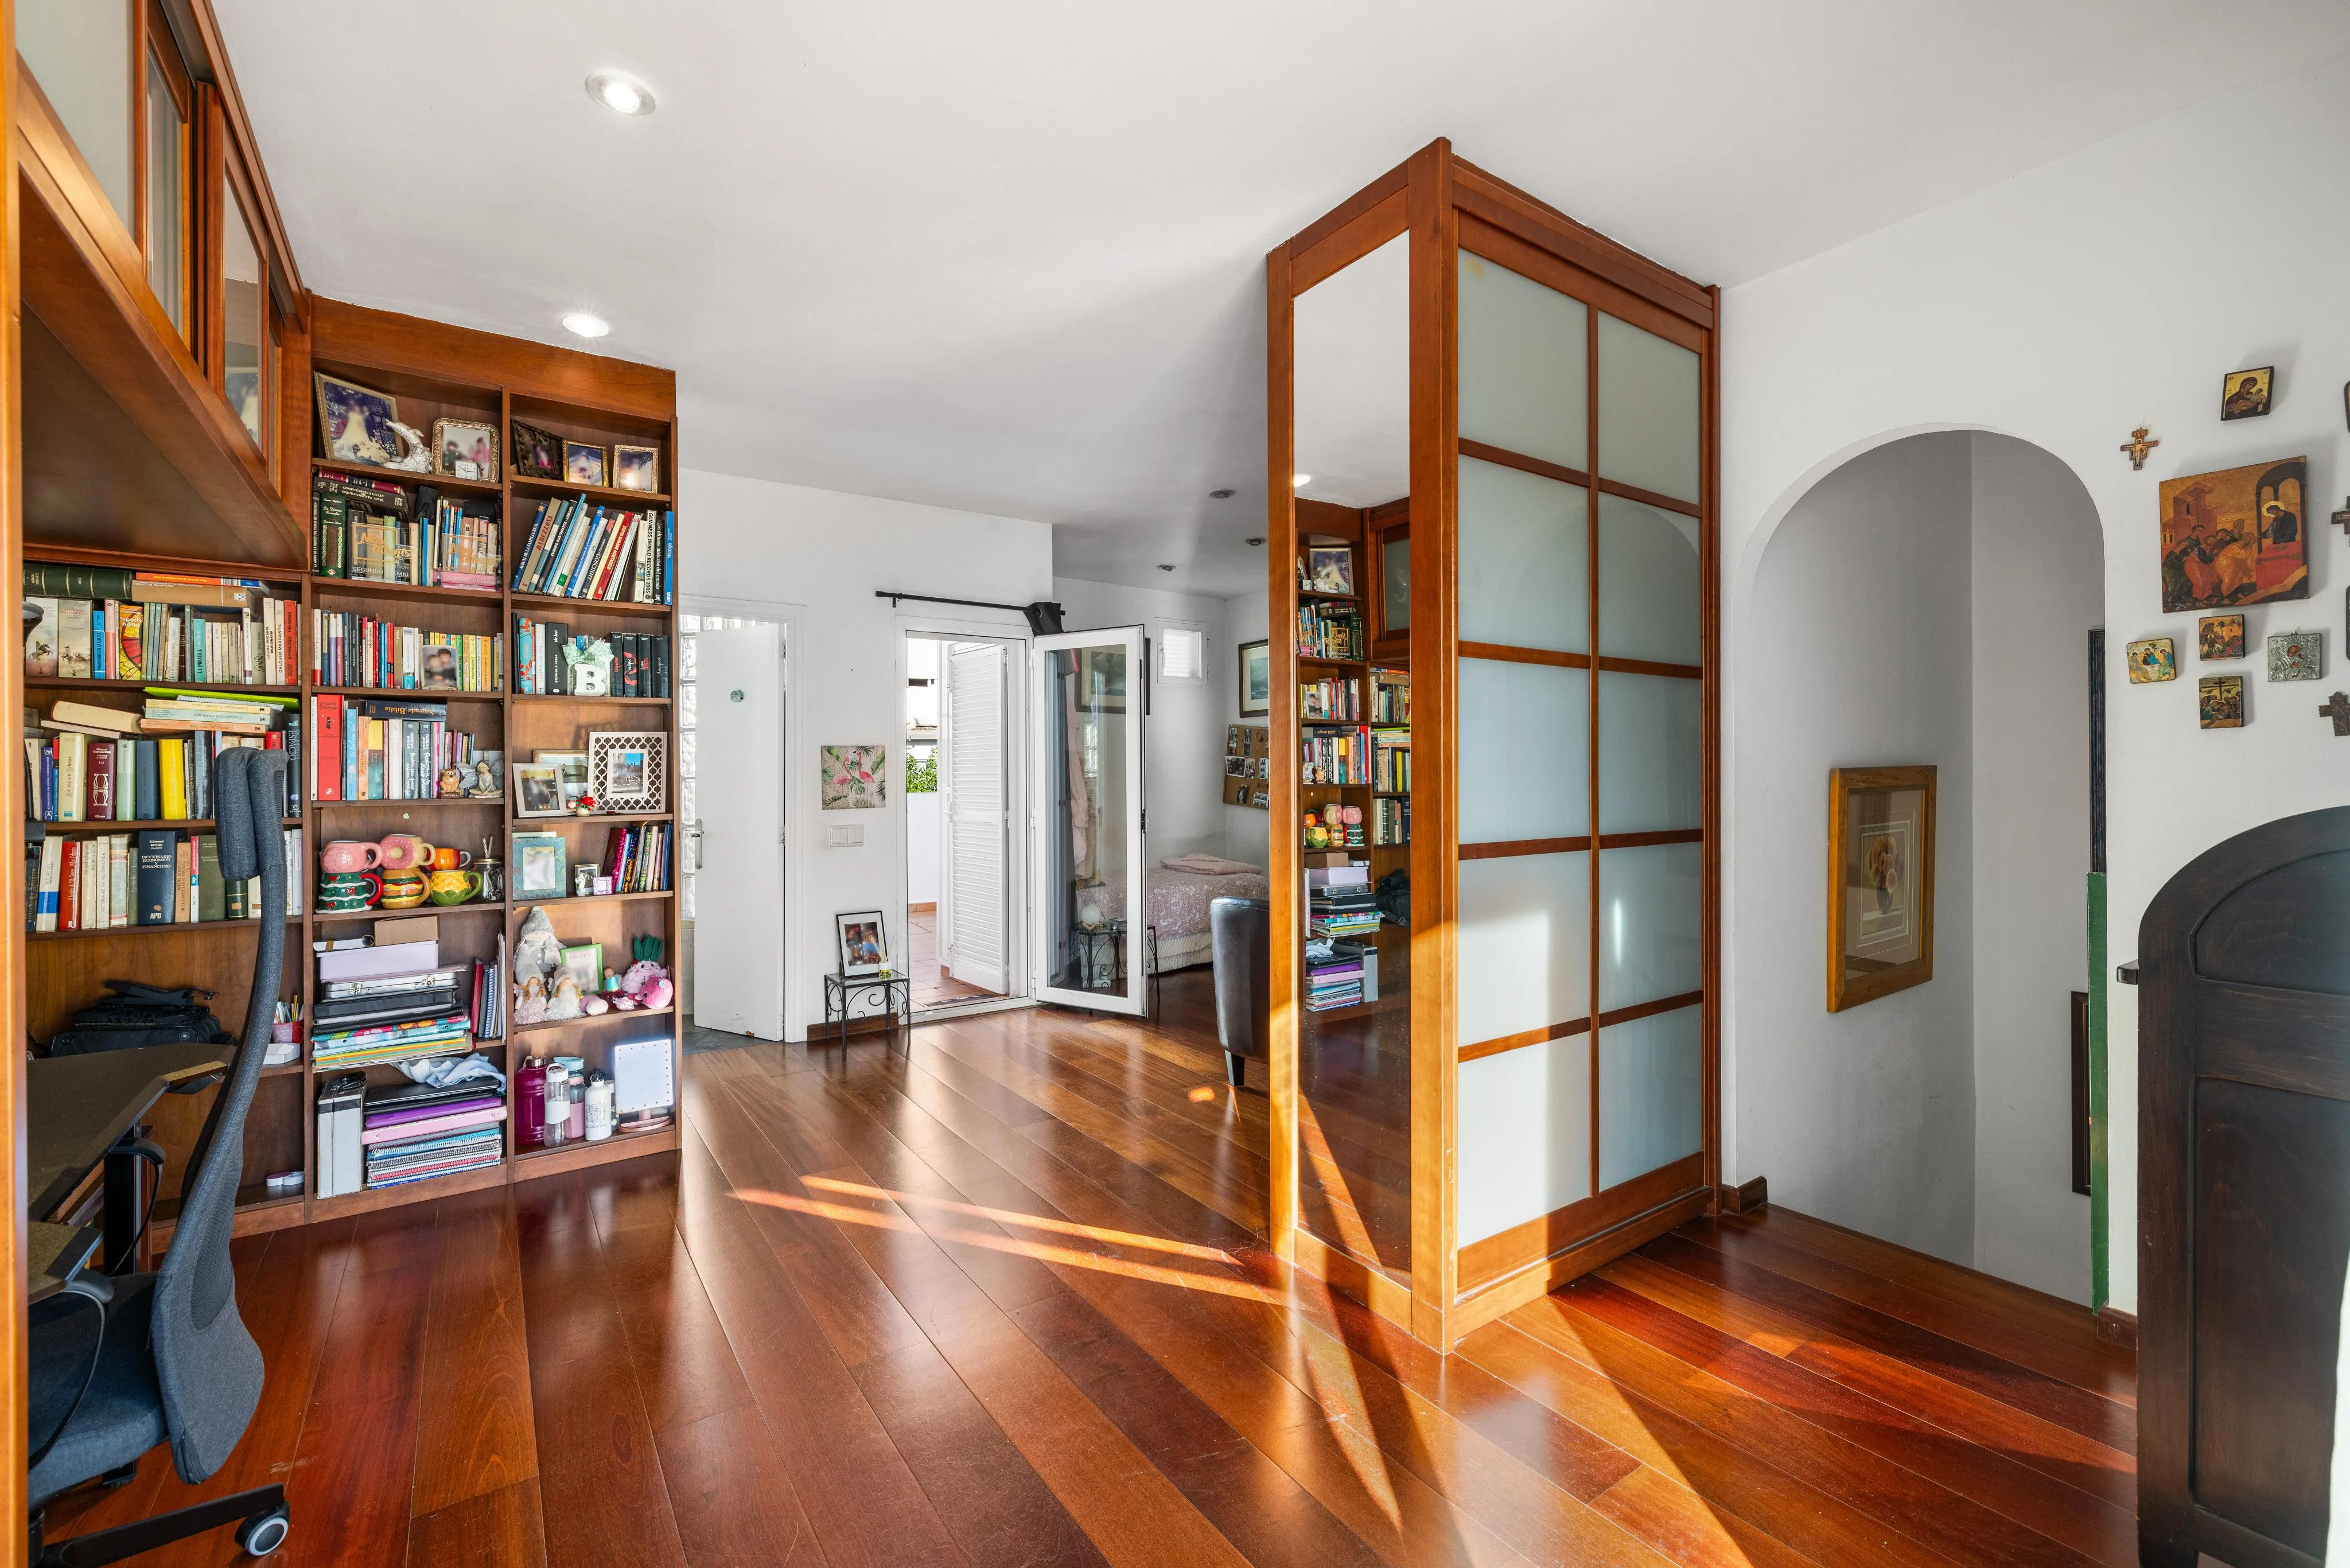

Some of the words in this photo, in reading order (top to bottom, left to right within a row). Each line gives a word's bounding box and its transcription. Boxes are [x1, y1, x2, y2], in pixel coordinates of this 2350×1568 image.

[526, 531, 536, 547] FAMILIA
[535, 515, 554, 551] BARCELONA
[556, 521, 568, 543] BUSTAMANTE
[619, 525, 627, 537] SUPER
[614, 536, 622, 551] HUMOR
[586, 553, 601, 581] GOSCINNY
[606, 550, 618, 570] MORTADELO
[352, 566, 383, 574] SEGUNDO
[656, 656, 665, 675] Amanecer
[385, 706, 406, 714] Biblia
[408, 708, 434, 716] Sagrada
[423, 752, 431, 772] Perdona
